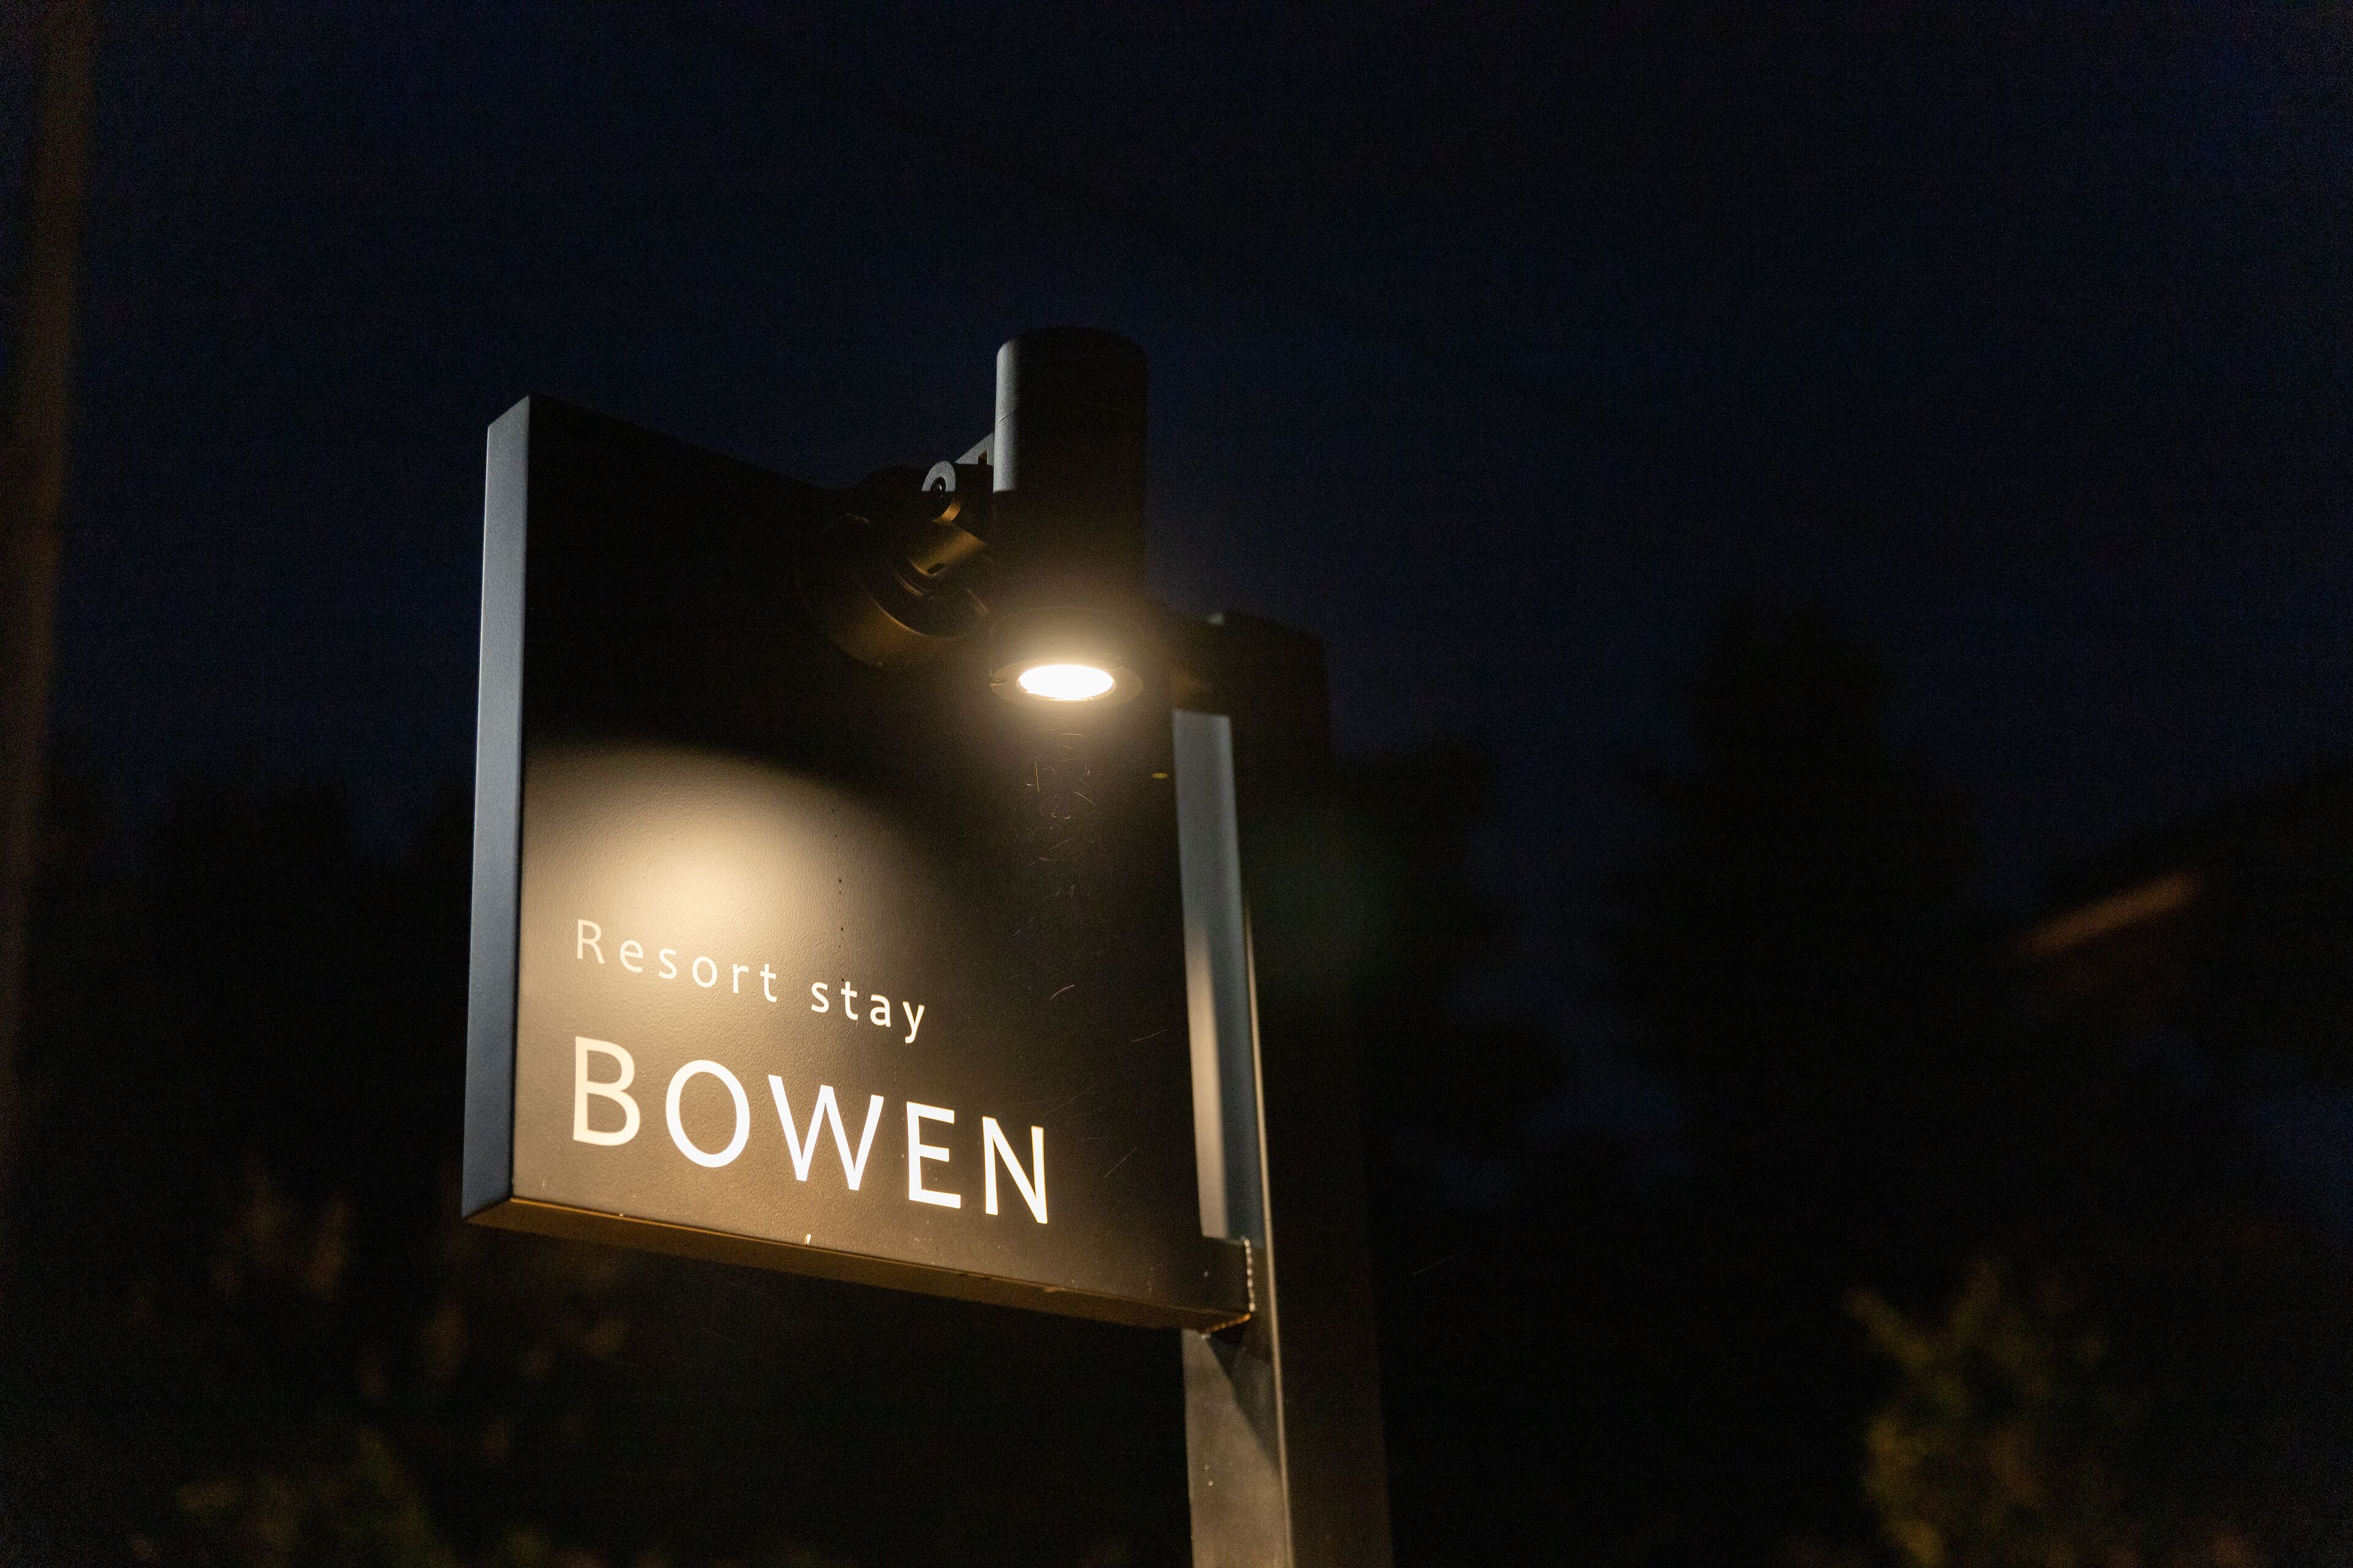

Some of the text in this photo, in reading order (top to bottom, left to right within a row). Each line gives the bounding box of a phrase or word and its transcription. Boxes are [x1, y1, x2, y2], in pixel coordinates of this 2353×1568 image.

[576, 919, 925, 1044] Resort stay
[573, 1036, 1048, 1224] BOWEN
